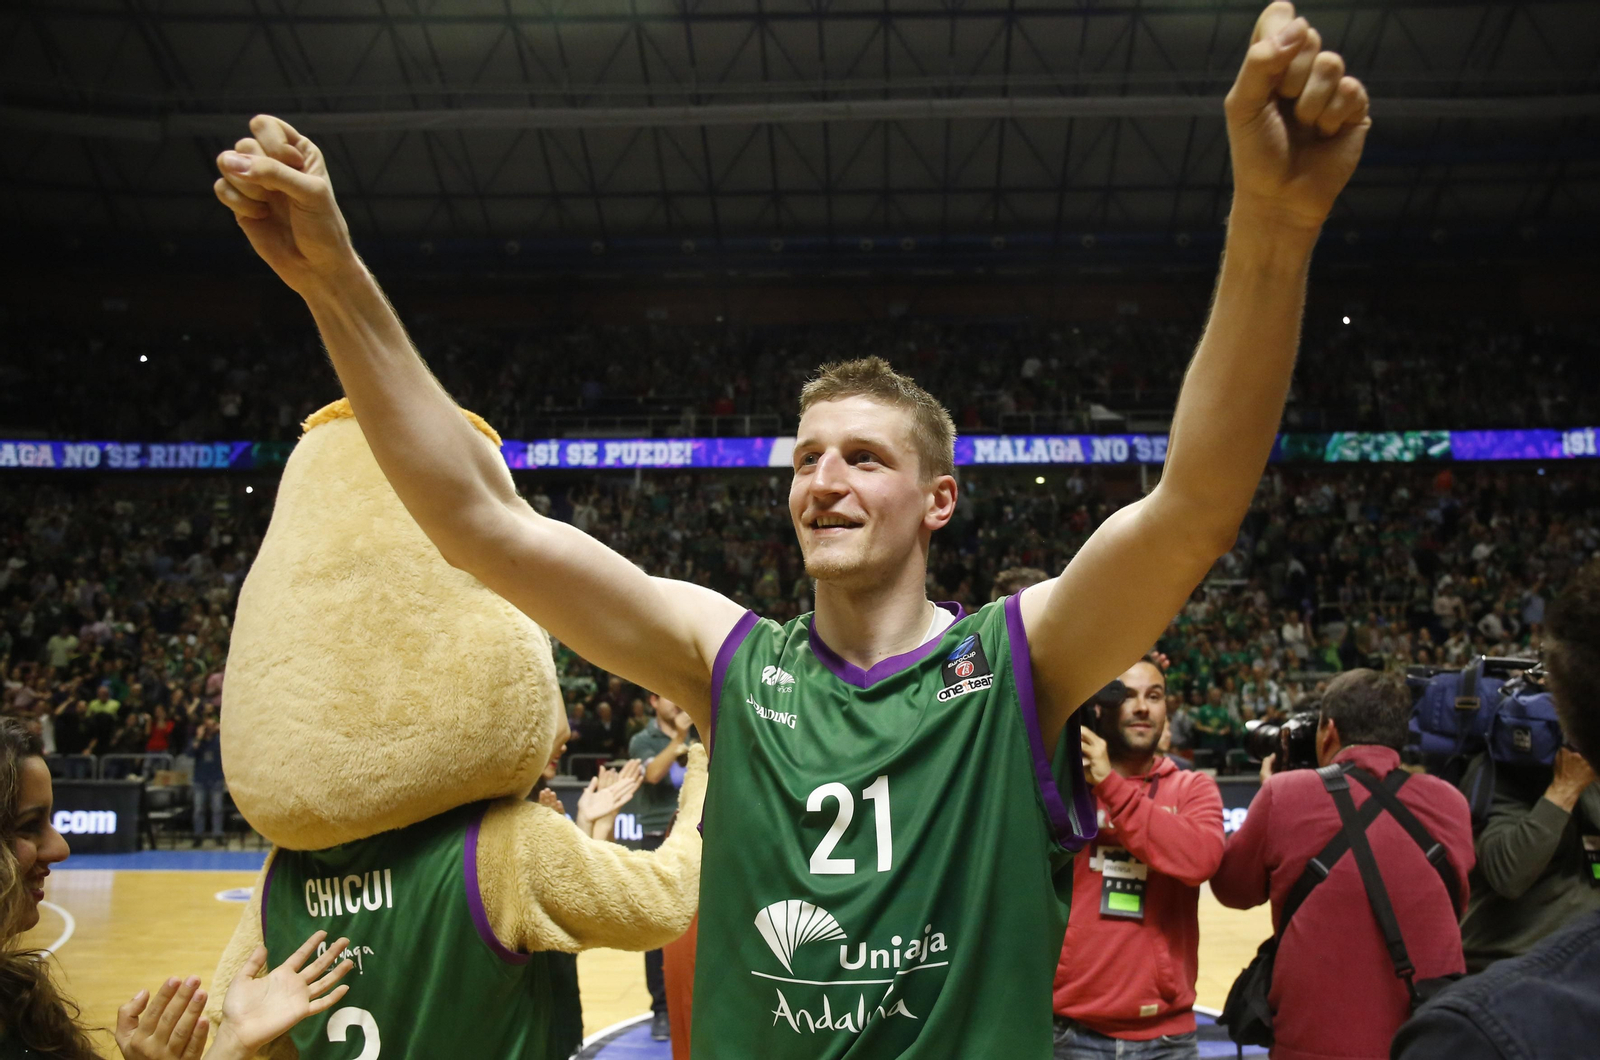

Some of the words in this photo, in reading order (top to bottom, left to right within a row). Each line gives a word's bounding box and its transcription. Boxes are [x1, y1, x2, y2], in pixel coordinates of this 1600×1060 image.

[0, 443, 56, 467] AGA
[63, 444, 101, 468] NO
[106, 444, 140, 468] SE
[148, 444, 230, 468] RINDE
[566, 442, 598, 466] SE
[604, 441, 693, 466] PUEDE!
[1091, 437, 1129, 463] NO
[1135, 437, 1168, 462] SE
[805, 774, 893, 875] 21
[305, 868, 393, 918] CHICUI
[839, 924, 948, 971] Uniaja
